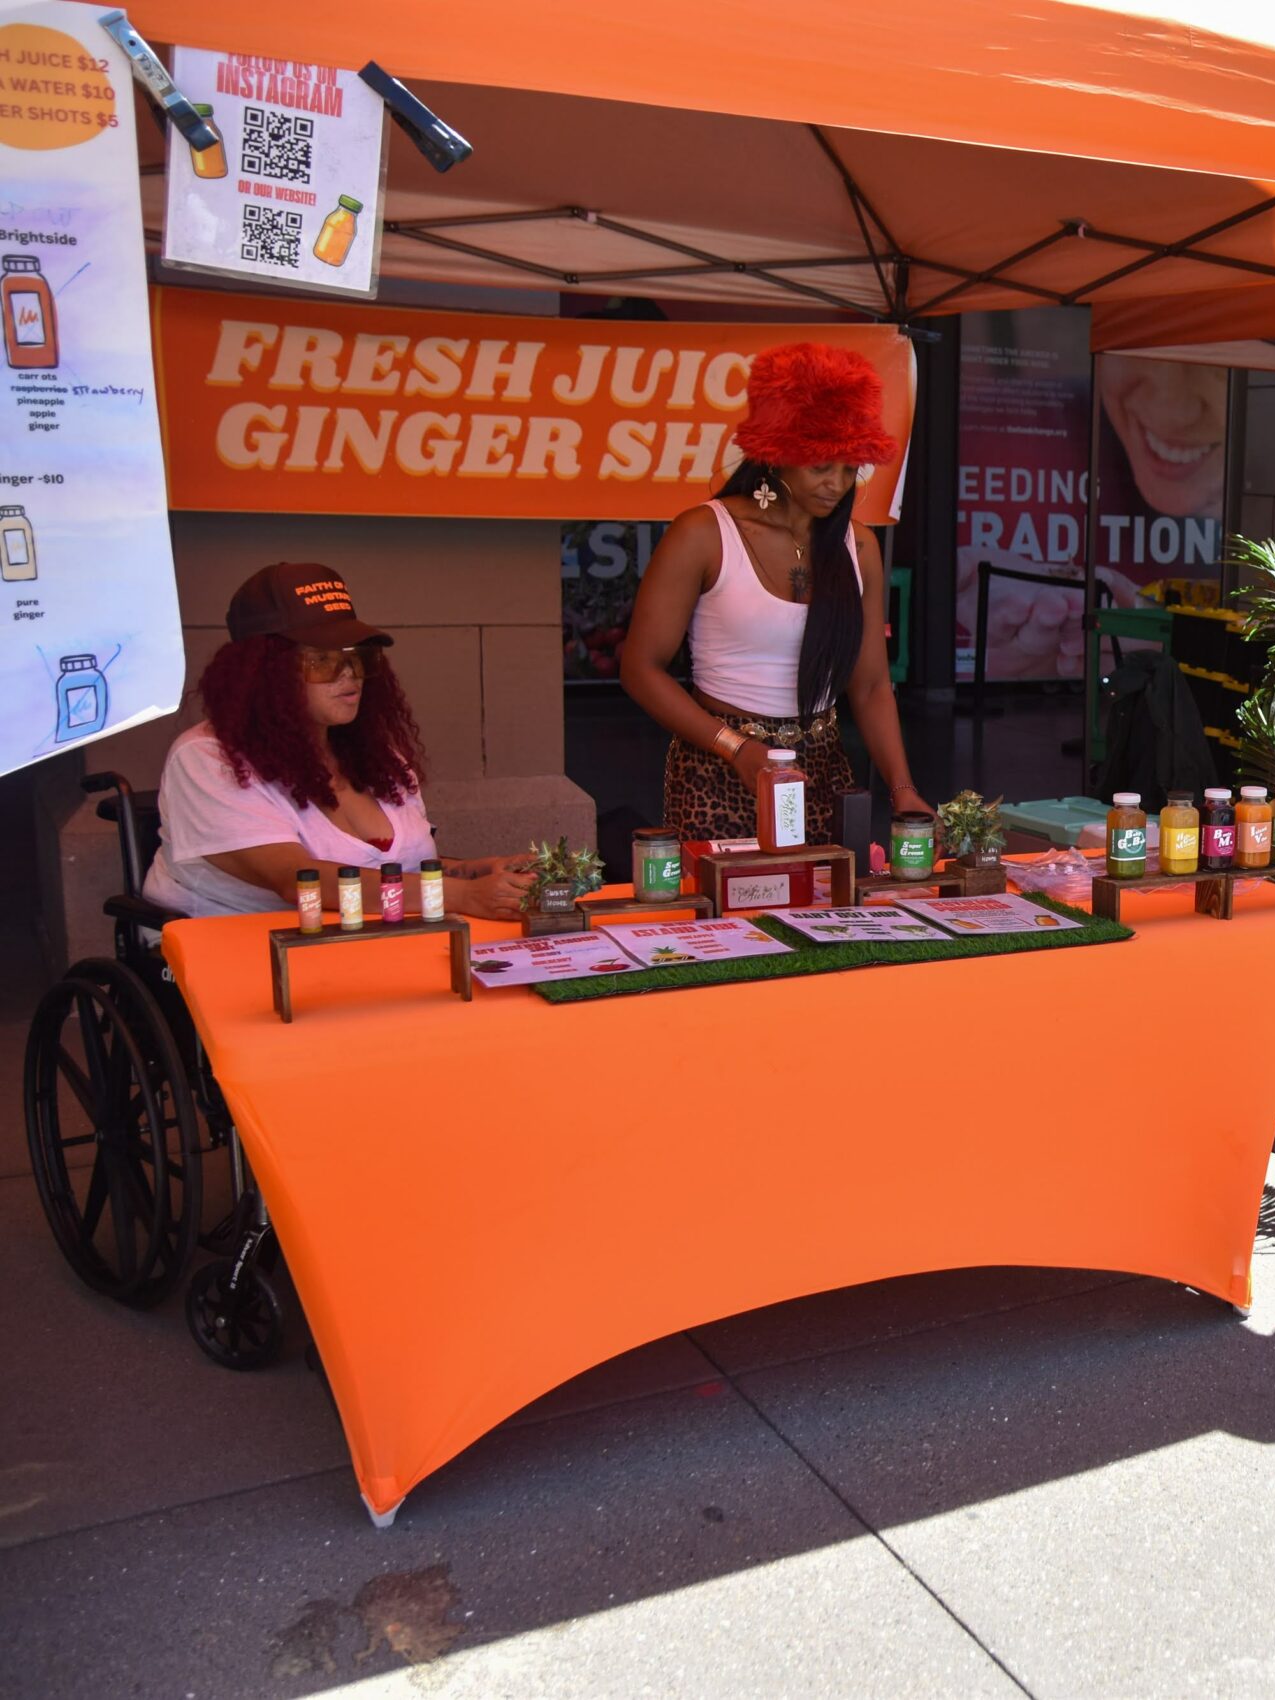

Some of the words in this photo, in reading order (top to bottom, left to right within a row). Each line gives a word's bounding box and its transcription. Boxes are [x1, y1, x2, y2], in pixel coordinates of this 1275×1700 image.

[17, 50, 72, 69] JUICE
[77, 55, 109, 73] $12
[10, 77, 76, 97] WATER
[81, 83, 116, 101] $10
[216, 61, 344, 118] INSTAGRAM
[27, 106, 92, 125] SHOTS
[96, 111, 119, 129] $5
[238, 179, 251, 195] OR
[253, 182, 273, 199] OUR
[275, 185, 317, 207] WEBSITE!
[0, 229, 78, 246] Brightside
[205, 319, 546, 402] FRESH
[552, 344, 756, 411] JUIC
[17, 397, 65, 407] pineapple
[29, 410, 56, 419] apple
[28, 422, 60, 432] ginger
[215, 403, 583, 480] GINGER
[295, 581, 334, 596] FAITH
[16, 599, 39, 608] pure
[13, 610, 46, 621] ginger
[903, 841, 923, 849] Super
[631, 925, 698, 938] ISLAND
[701, 922, 743, 931] VIBE
